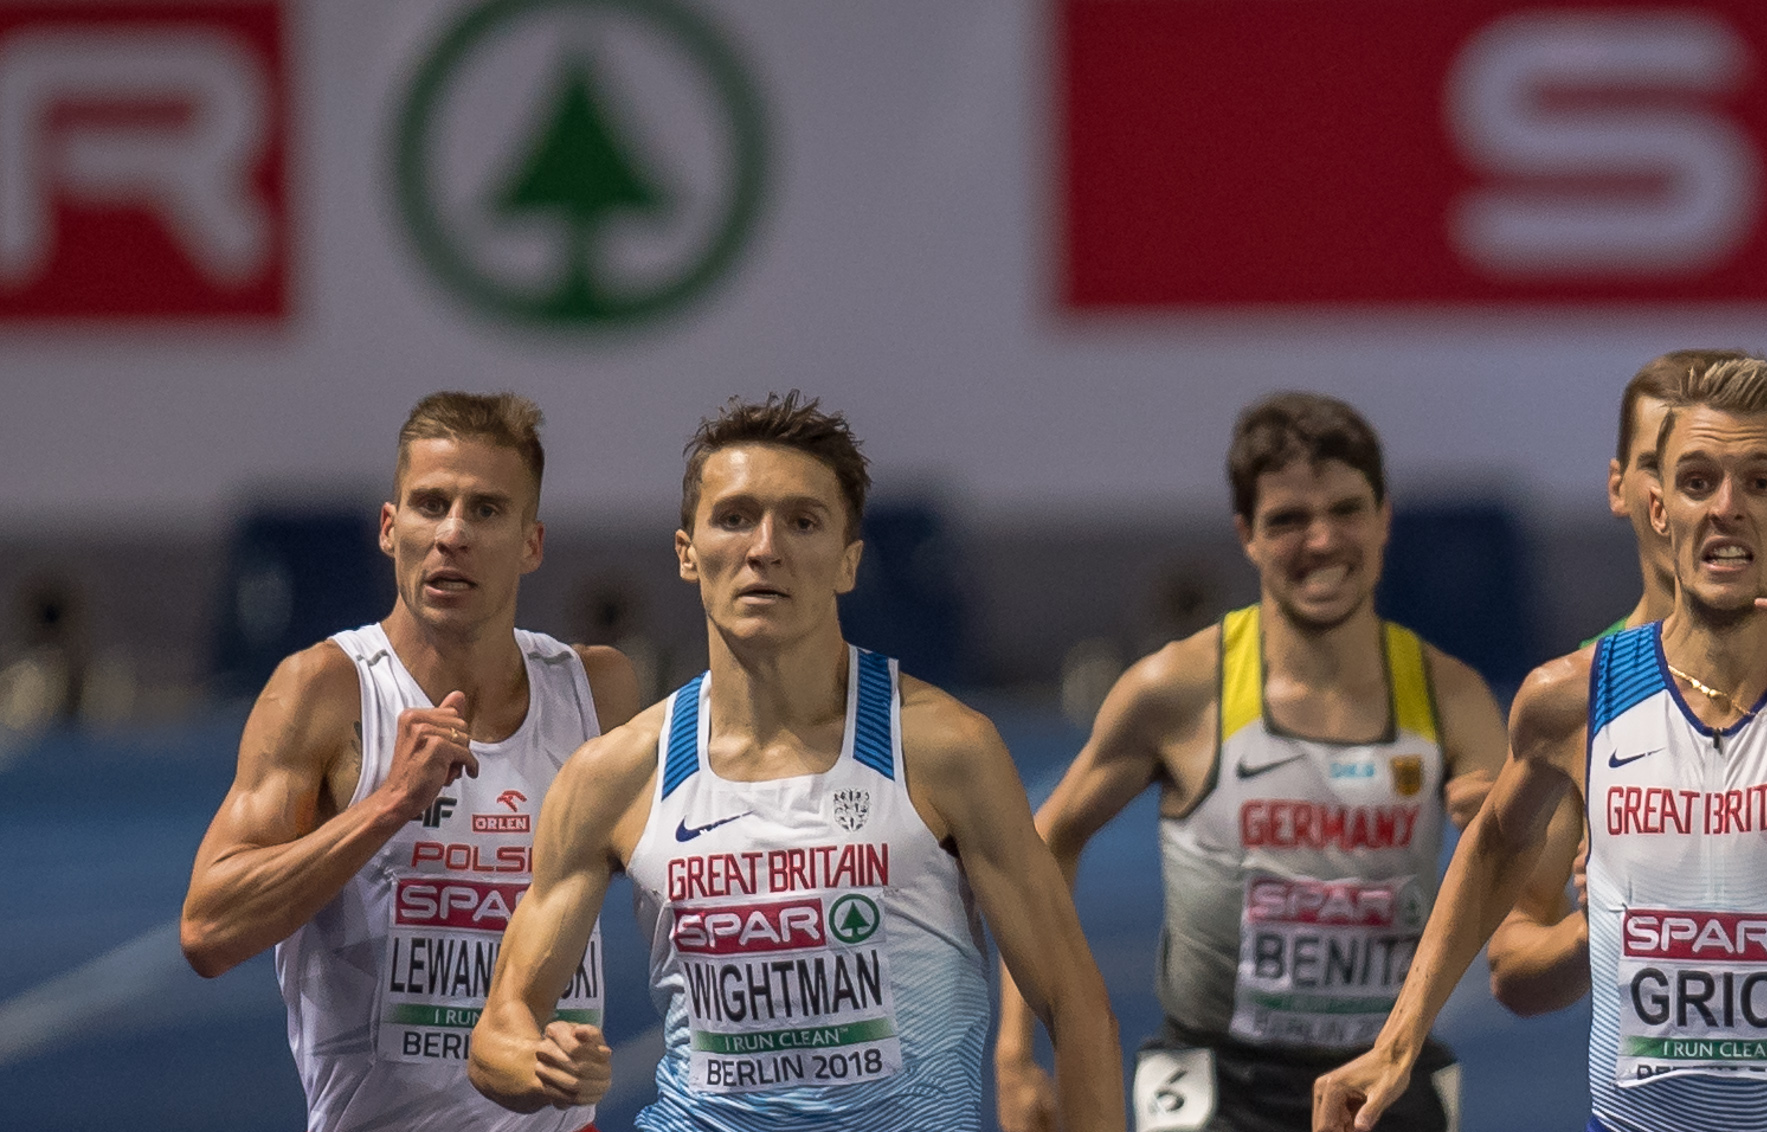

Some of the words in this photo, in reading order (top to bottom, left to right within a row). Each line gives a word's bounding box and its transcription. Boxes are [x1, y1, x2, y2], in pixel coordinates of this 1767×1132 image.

[475, 816, 528, 831] ORLEN
[1240, 800, 1420, 851] GERMANY
[1607, 785, 1701, 836] GREAT
[410, 841, 532, 872] POLS
[667, 851, 763, 902] GREAT
[767, 842, 889, 894] BRITAIN
[400, 884, 526, 923] SPA
[1251, 882, 1392, 923] SPAR
[676, 905, 821, 949] SPAR
[684, 949, 883, 1023] WIGHTMAN
[725, 1036, 731, 1051] I
[734, 1033, 774, 1051] RUN
[1663, 1041, 1668, 1056] I
[1673, 1041, 1713, 1057] RUN
[706, 1053, 805, 1087] BERLIN
[811, 1048, 883, 1080] 2018
